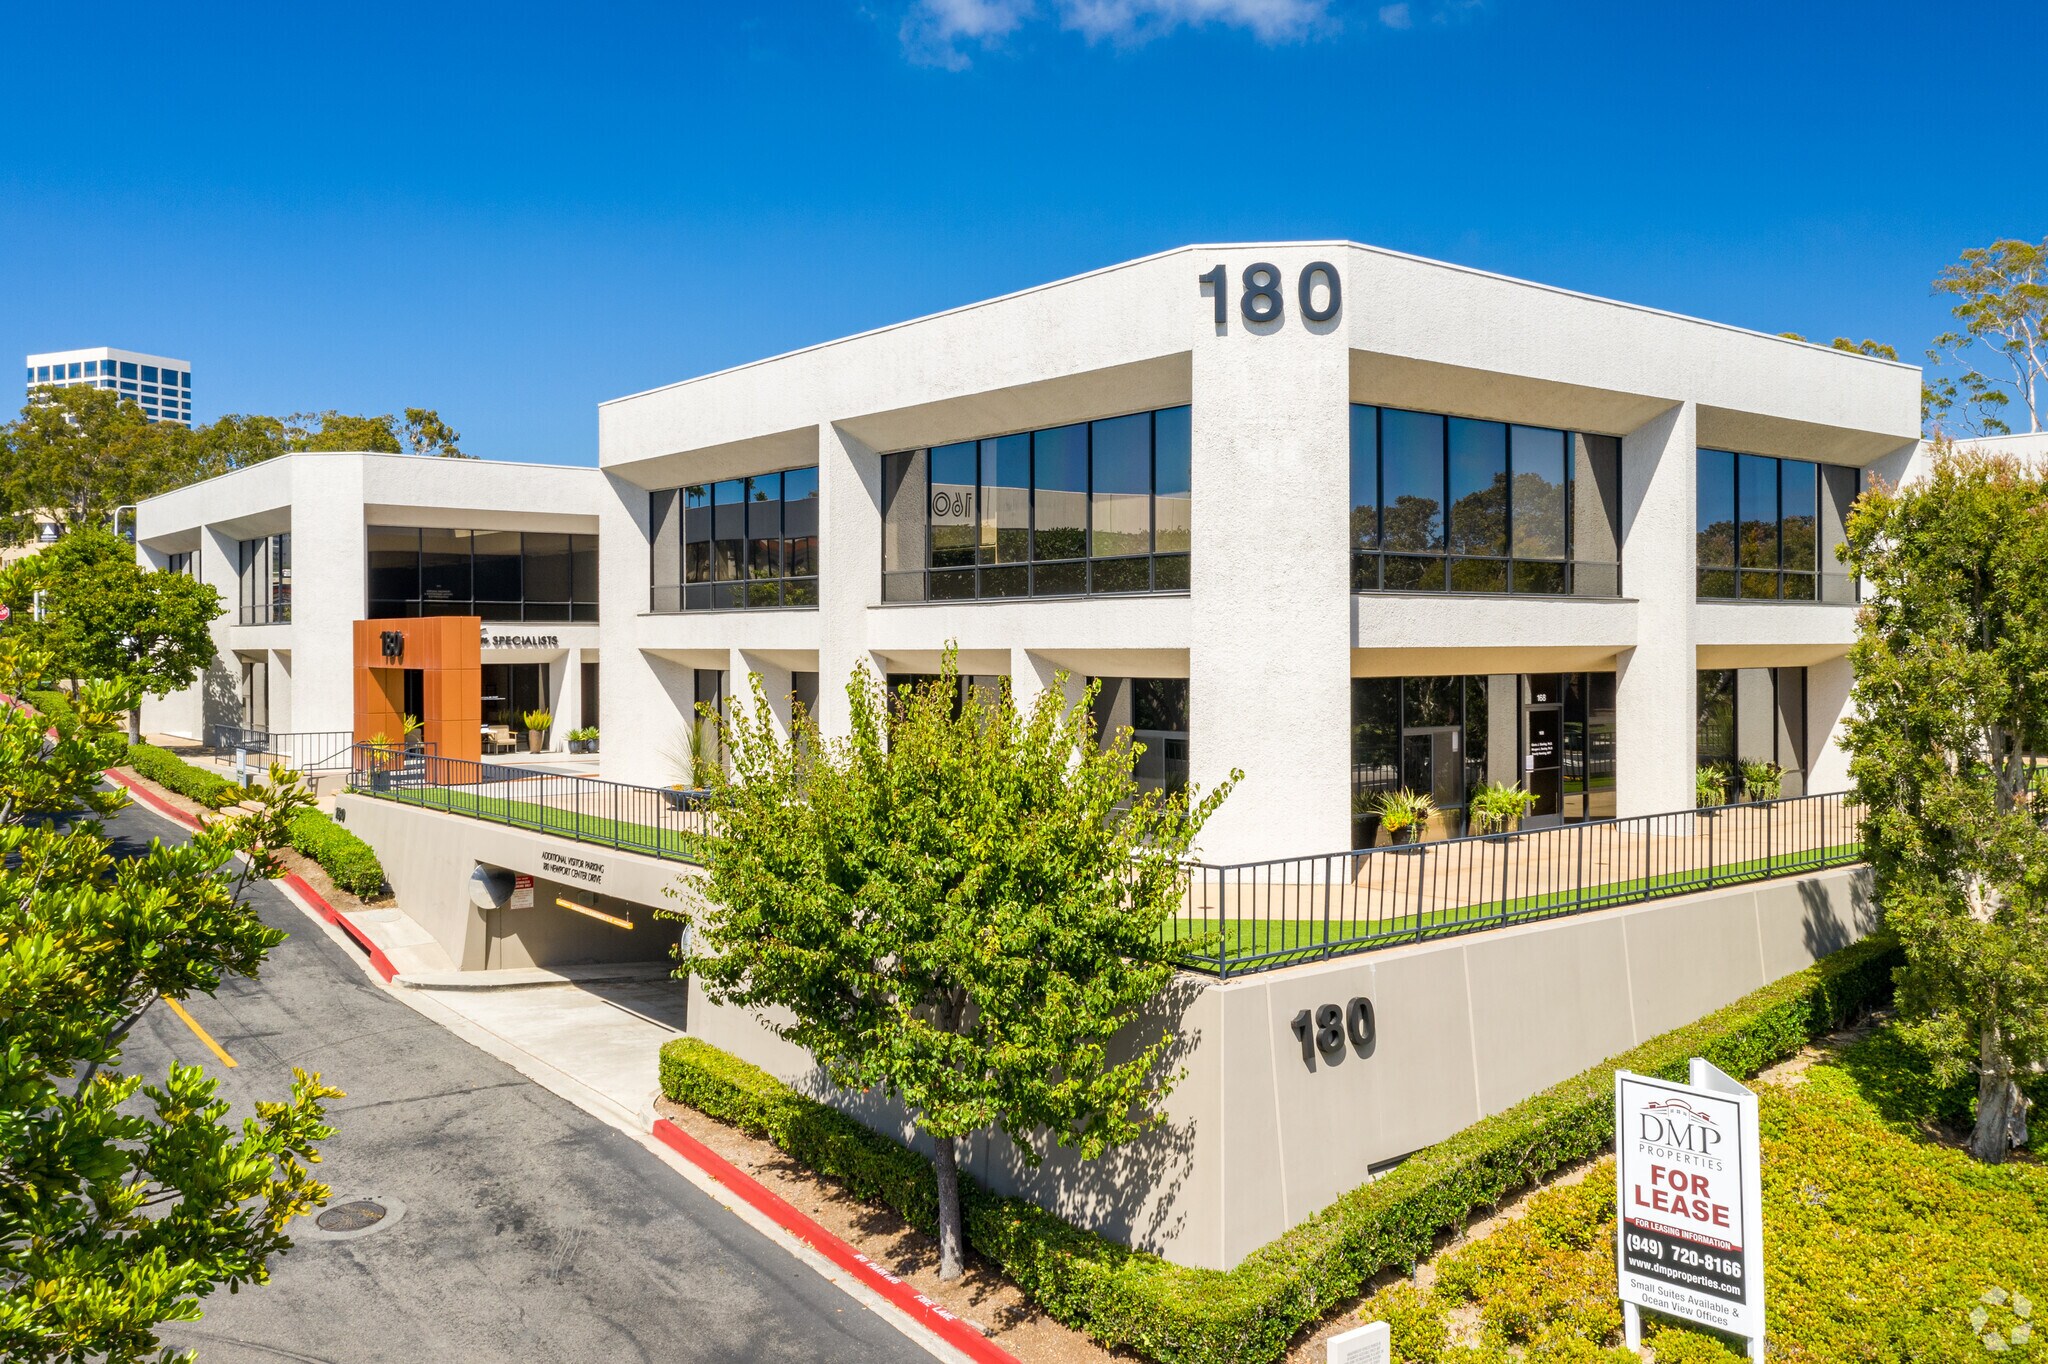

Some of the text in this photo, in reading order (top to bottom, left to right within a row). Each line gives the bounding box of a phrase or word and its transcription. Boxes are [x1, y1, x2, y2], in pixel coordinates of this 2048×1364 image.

[1199, 261, 1342, 323] 180
[492, 635, 558, 647] SPECIALISTS
[542, 852, 604, 873] ADDITIONAL VISITOR PARKING
[551, 865, 571, 876] NEWPORT
[571, 869, 587, 880] CENTER
[588, 873, 601, 884] DRIVE
[1290, 996, 1376, 1060] 180
[1640, 1113, 1721, 1155] DMP
[1639, 1143, 1723, 1172] PROPERTIES
[1651, 1163, 1711, 1199] FOR
[1634, 1183, 1730, 1229] LEASE
[1635, 1218, 1732, 1251] FOR LEASING INFORMATION
[1626, 1233, 1742, 1278] (949) 720-8166
[1628, 1257, 1741, 1296] www.dmpproperties.com
[1630, 1278, 1740, 1318] Small Suites Available &
[1641, 1292, 1729, 1326] Ocean View Offices
